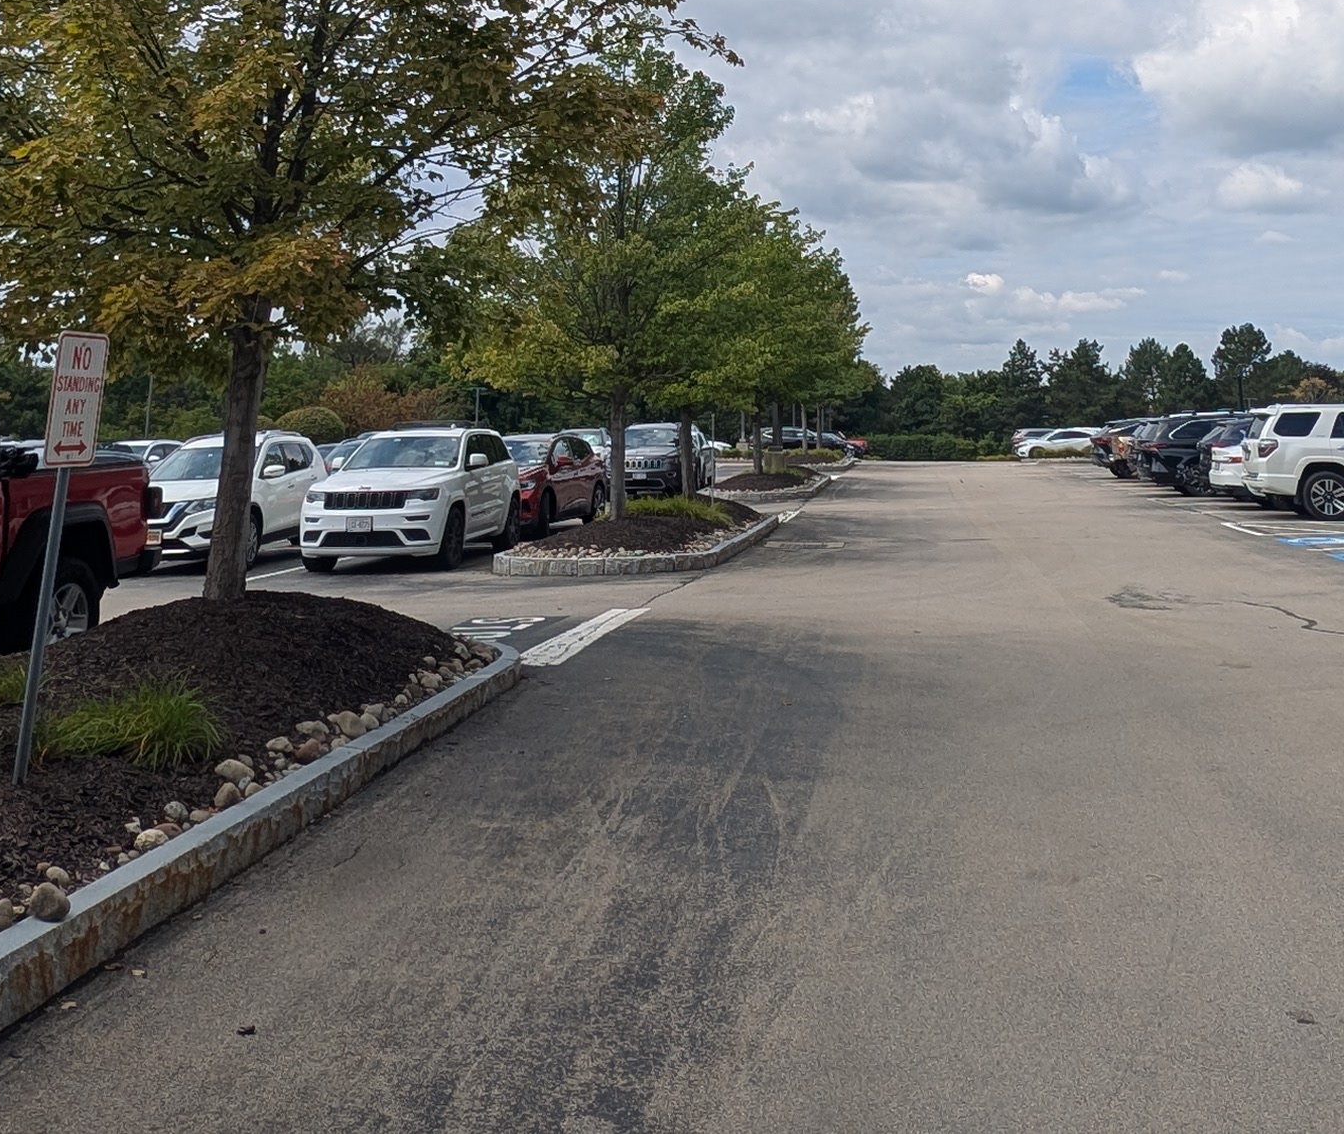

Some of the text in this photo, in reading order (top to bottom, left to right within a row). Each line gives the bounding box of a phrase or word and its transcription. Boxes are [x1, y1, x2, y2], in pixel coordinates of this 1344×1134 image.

[72, 346, 92, 370] NO
[57, 376, 101, 393] STANDING
[65, 399, 87, 415] ANY
[62, 421, 85, 438] TIME
